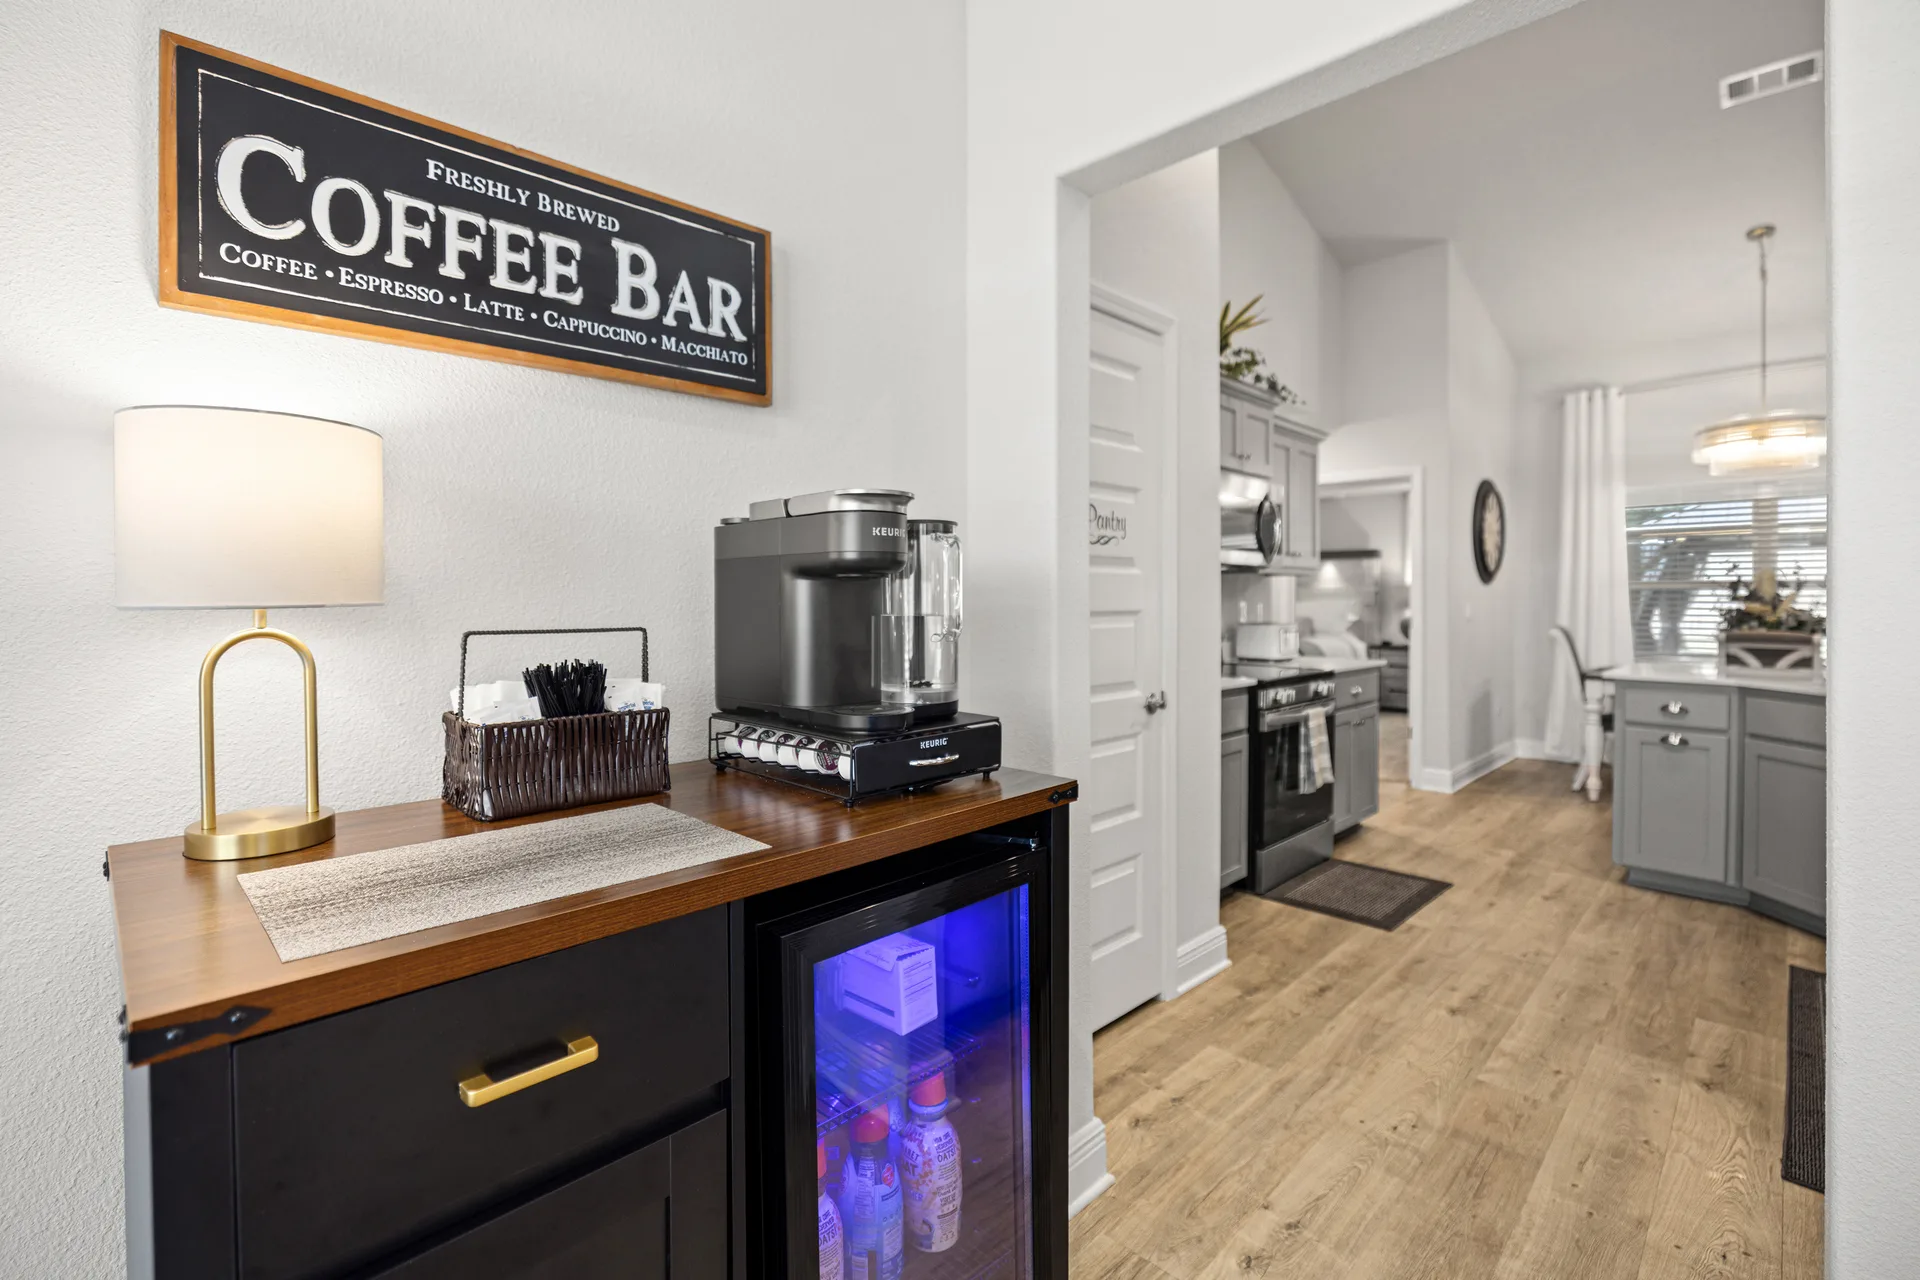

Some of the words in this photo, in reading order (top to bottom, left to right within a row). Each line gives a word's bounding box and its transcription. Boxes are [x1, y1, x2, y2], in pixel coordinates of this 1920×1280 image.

[214, 134, 585, 306] COFFEE
[610, 237, 748, 343] BAR
[426, 159, 531, 206] FRESHLY
[537, 192, 620, 233] BREWED
[219, 242, 319, 281] COFFEE
[338, 267, 444, 305] ESPRESSO
[463, 293, 526, 322] LATTE
[543, 310, 648, 346] CAPPUCCINO
[660, 334, 749, 366] MACCHIATO
[920, 737, 948, 749] KEURIG
